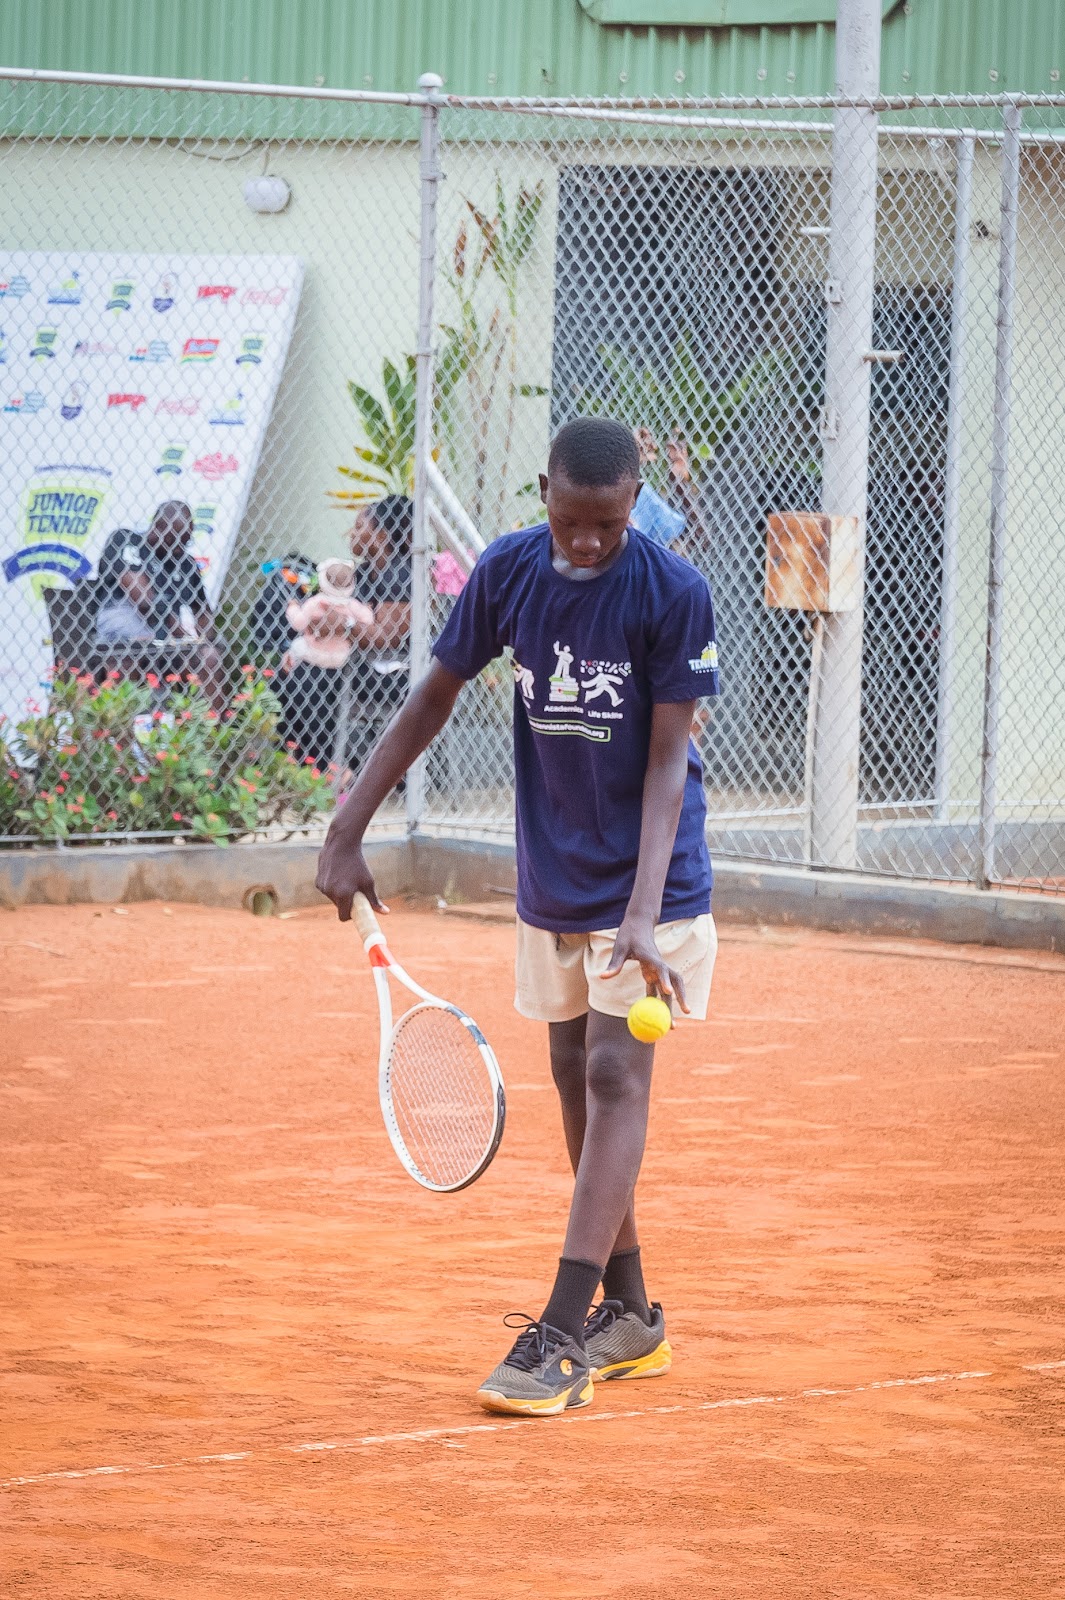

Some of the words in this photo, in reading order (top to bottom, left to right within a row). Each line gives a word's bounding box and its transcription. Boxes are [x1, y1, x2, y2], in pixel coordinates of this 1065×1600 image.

[29, 492, 99, 516] JUNIOR
[28, 514, 92, 536] TENNIS
[543, 704, 584, 714] Academics
[587, 709, 602, 719] Life
[601, 711, 624, 720] Skills
